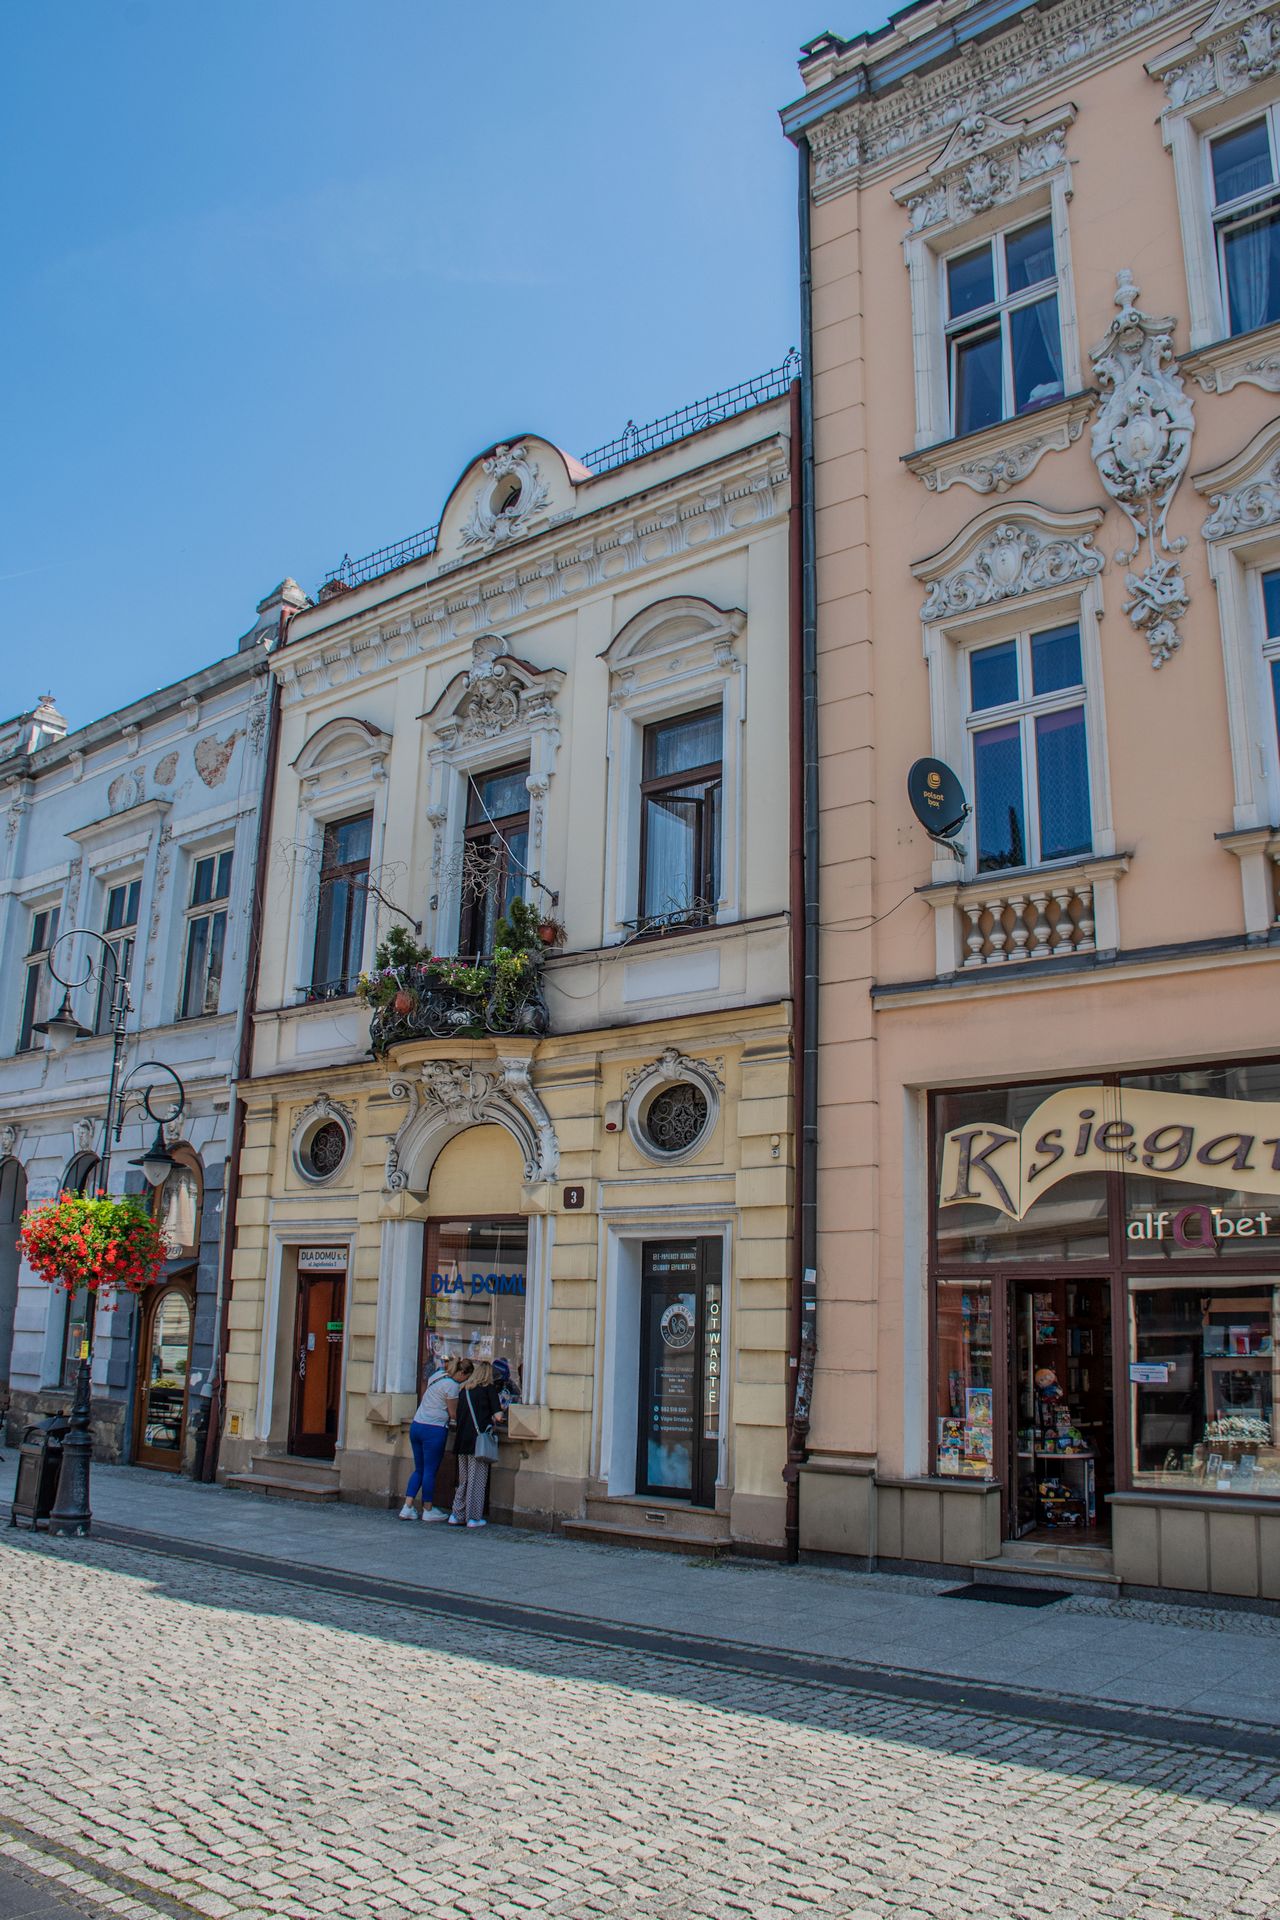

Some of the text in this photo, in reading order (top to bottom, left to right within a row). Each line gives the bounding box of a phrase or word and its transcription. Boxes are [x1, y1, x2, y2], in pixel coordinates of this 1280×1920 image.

[923, 791, 945, 801] polsat
[928, 798, 940, 807] box
[570, 1191, 577, 1204] 3
[301, 1251, 314, 1260] DLA
[315, 1251, 337, 1260] DOMU
[431, 1273, 464, 1294] DLA
[709, 1303, 720, 1403] OTWARTE
